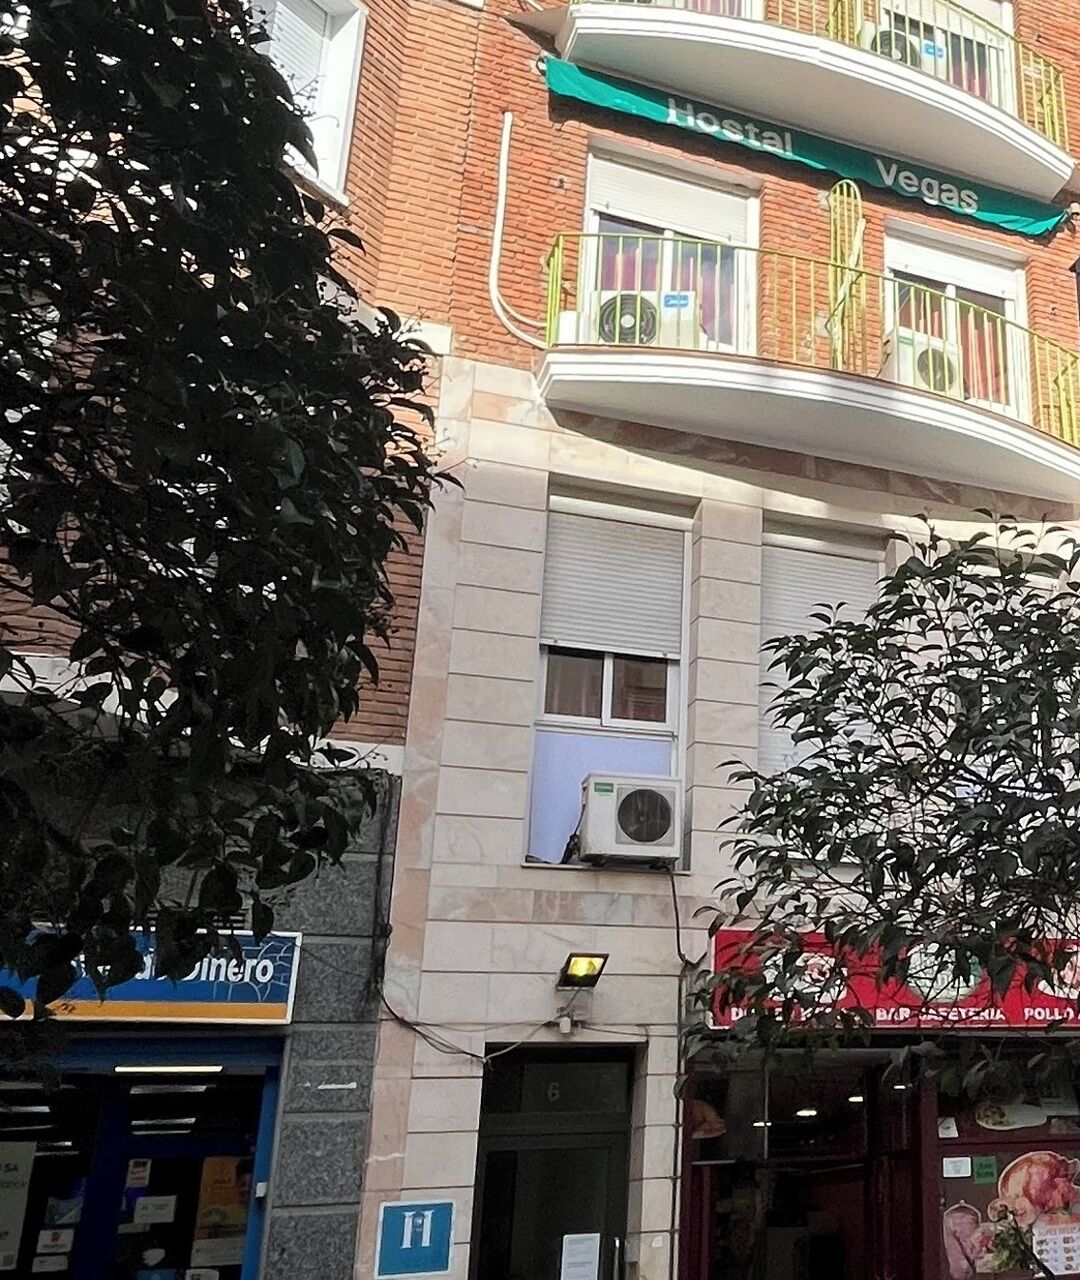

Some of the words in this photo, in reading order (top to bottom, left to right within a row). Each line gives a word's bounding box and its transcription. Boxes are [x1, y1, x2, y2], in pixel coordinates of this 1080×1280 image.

[666, 98, 793, 155] Hostal
[874, 158, 979, 215] Vegas
[1023, 1006, 1075, 1021] POLLO
